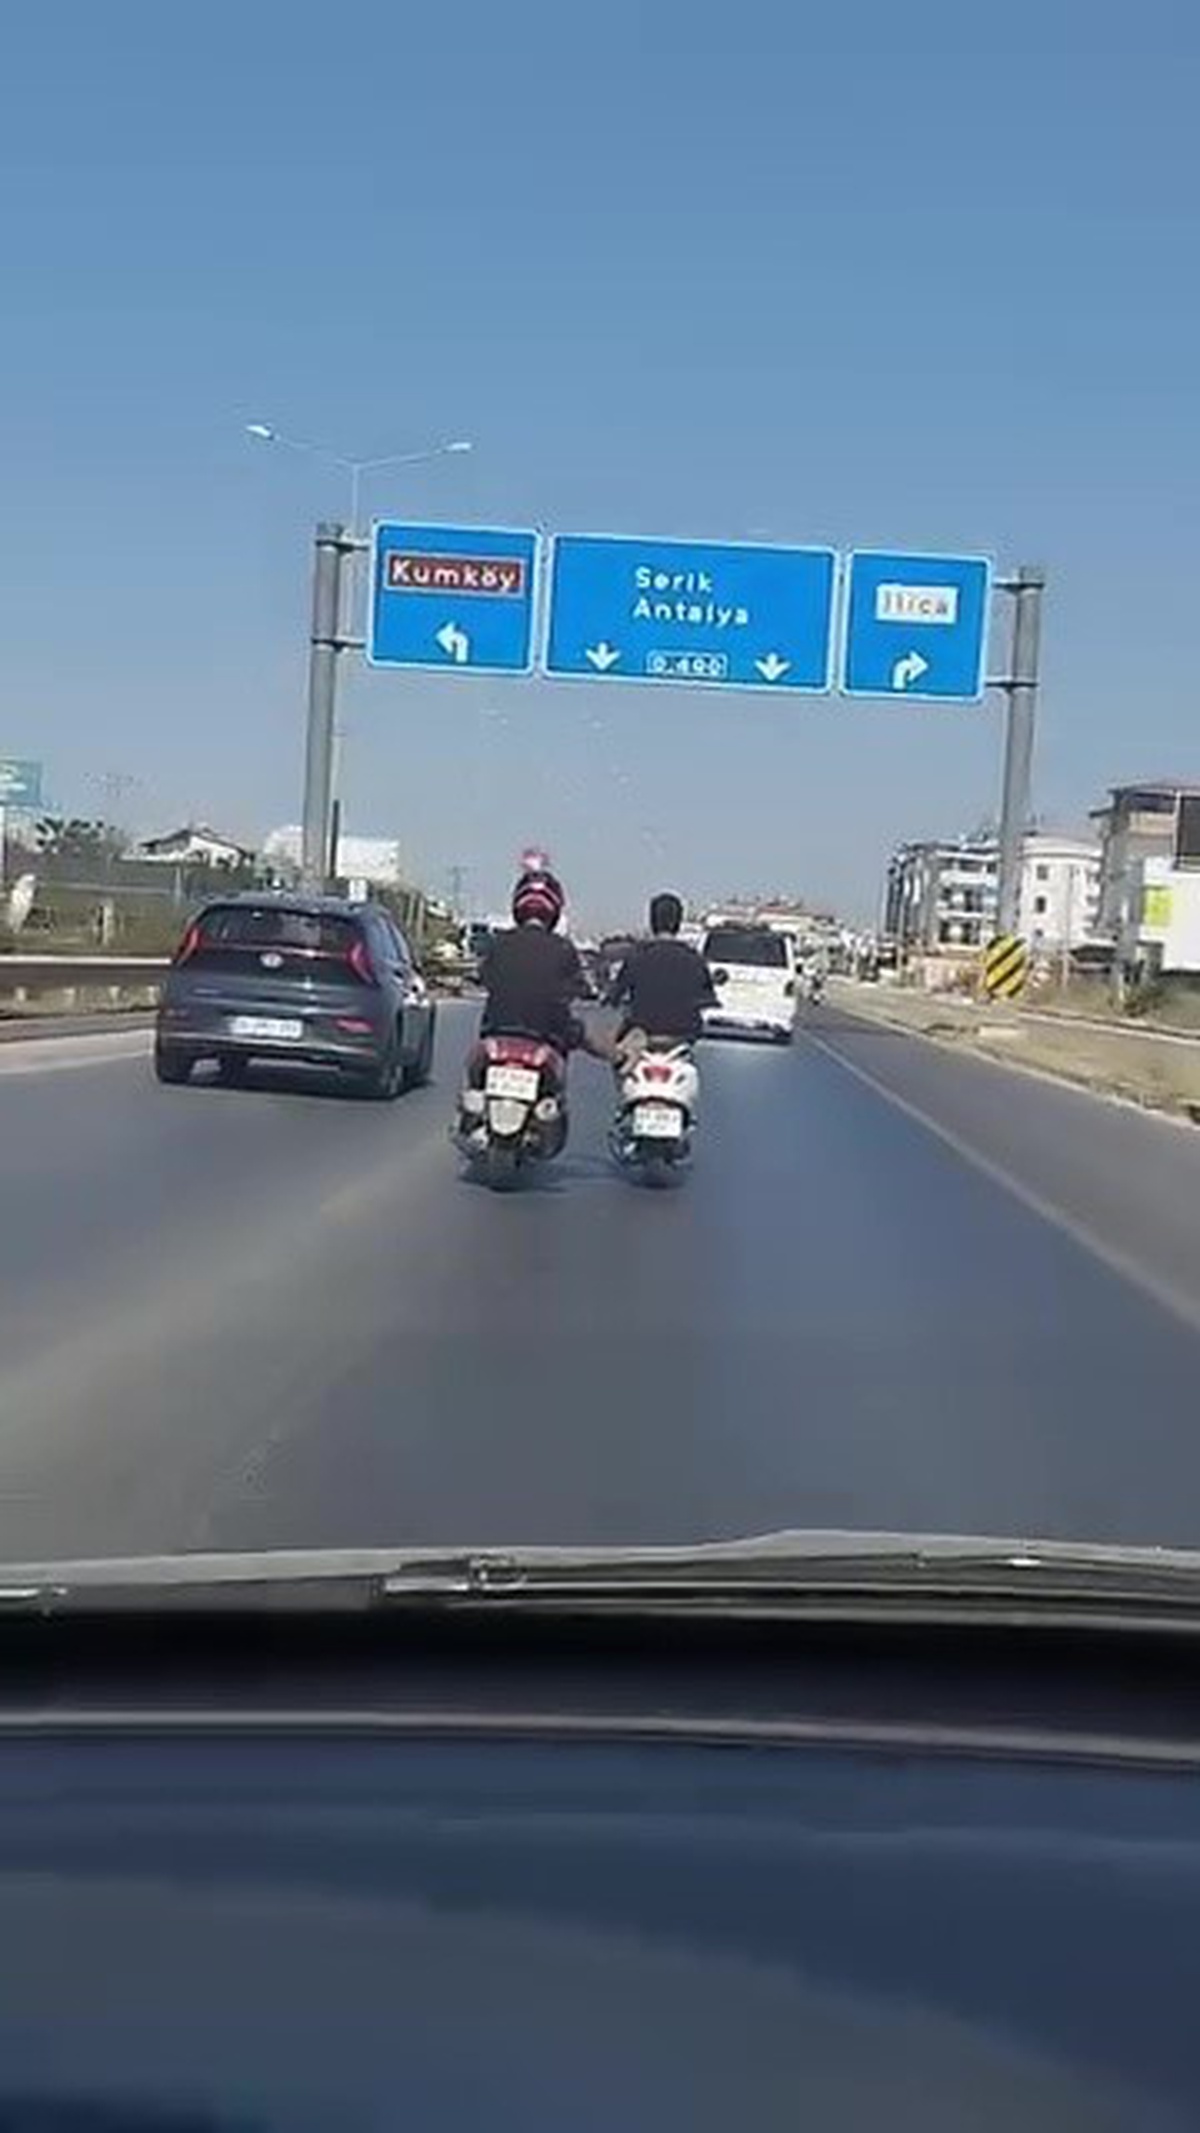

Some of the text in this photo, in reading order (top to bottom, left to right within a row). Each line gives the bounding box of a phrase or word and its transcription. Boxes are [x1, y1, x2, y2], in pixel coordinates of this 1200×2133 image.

[392, 558, 516, 592] Kumköy
[635, 566, 713, 593] Serik
[632, 597, 749, 628] Antalya
